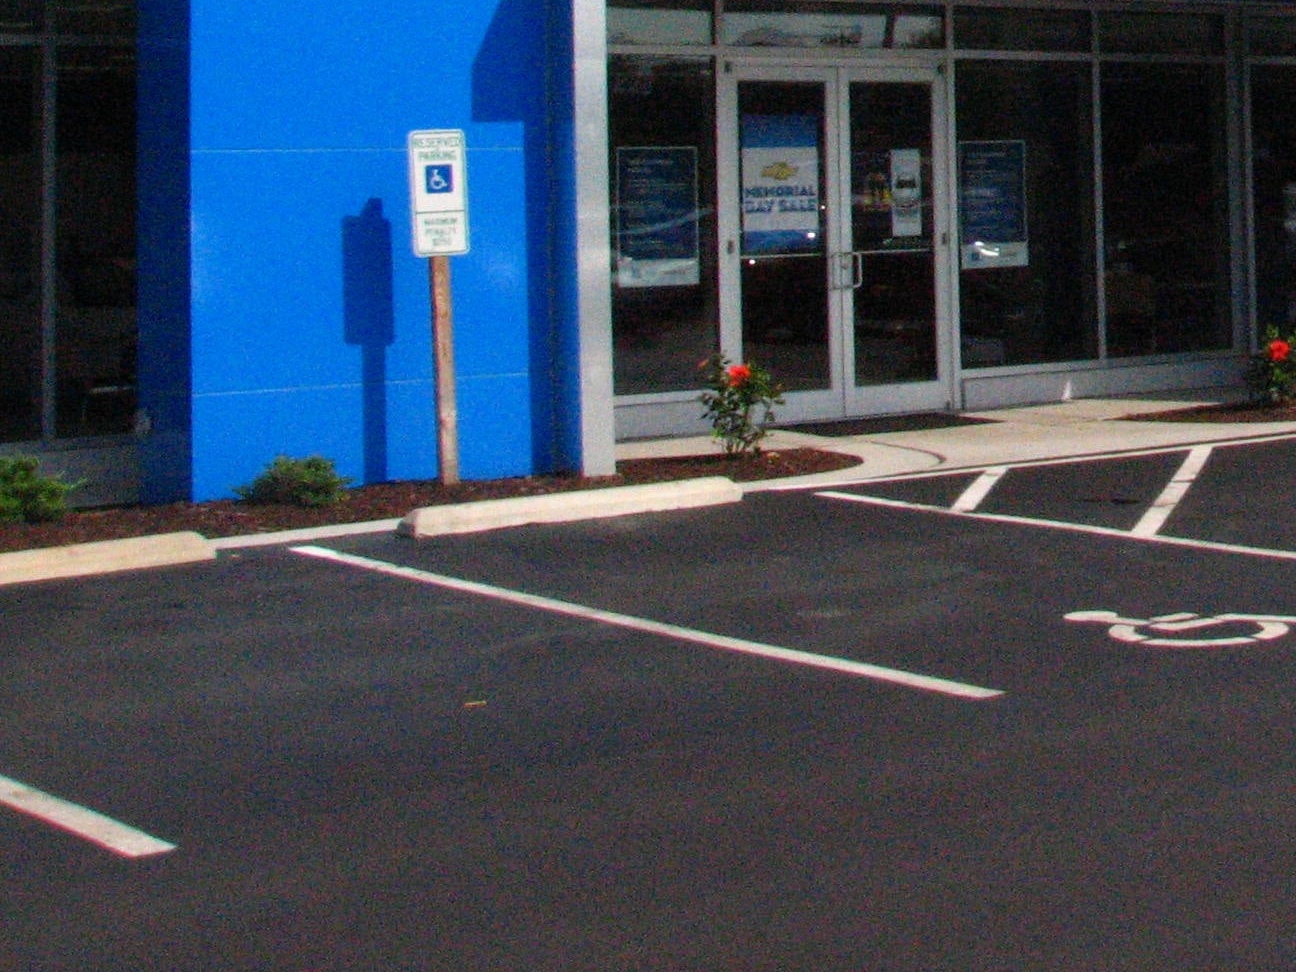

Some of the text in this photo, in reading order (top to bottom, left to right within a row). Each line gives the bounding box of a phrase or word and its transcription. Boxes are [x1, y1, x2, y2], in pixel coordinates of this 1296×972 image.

[418, 150, 457, 161] PARKING
[745, 185, 817, 198] MEMORIAL
[745, 199, 773, 214] DAY
